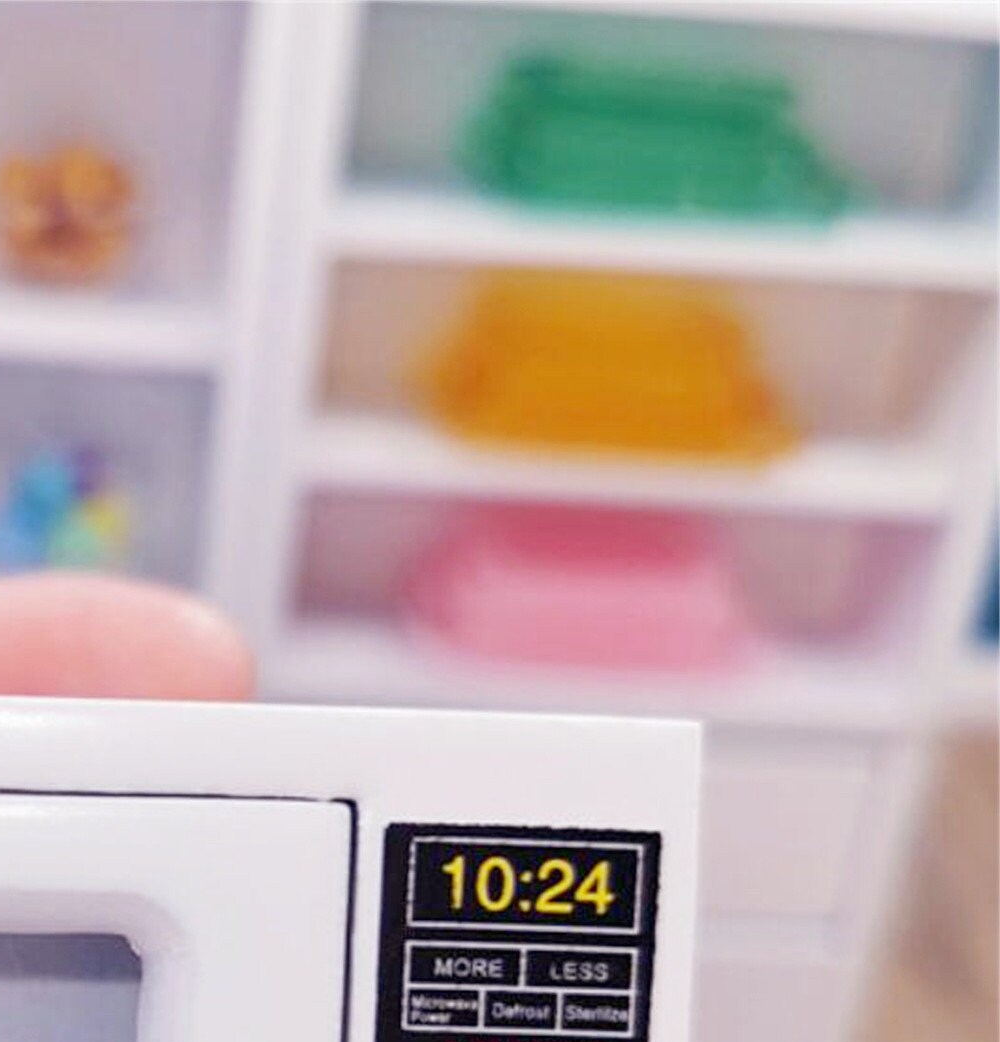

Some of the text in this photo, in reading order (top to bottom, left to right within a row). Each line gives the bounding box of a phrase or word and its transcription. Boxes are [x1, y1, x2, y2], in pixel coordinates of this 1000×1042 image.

[442, 855, 615, 915] 10:24
[434, 957, 504, 978] MORE
[550, 962, 609, 982] LESS
[491, 1002, 550, 1021] Defrost
